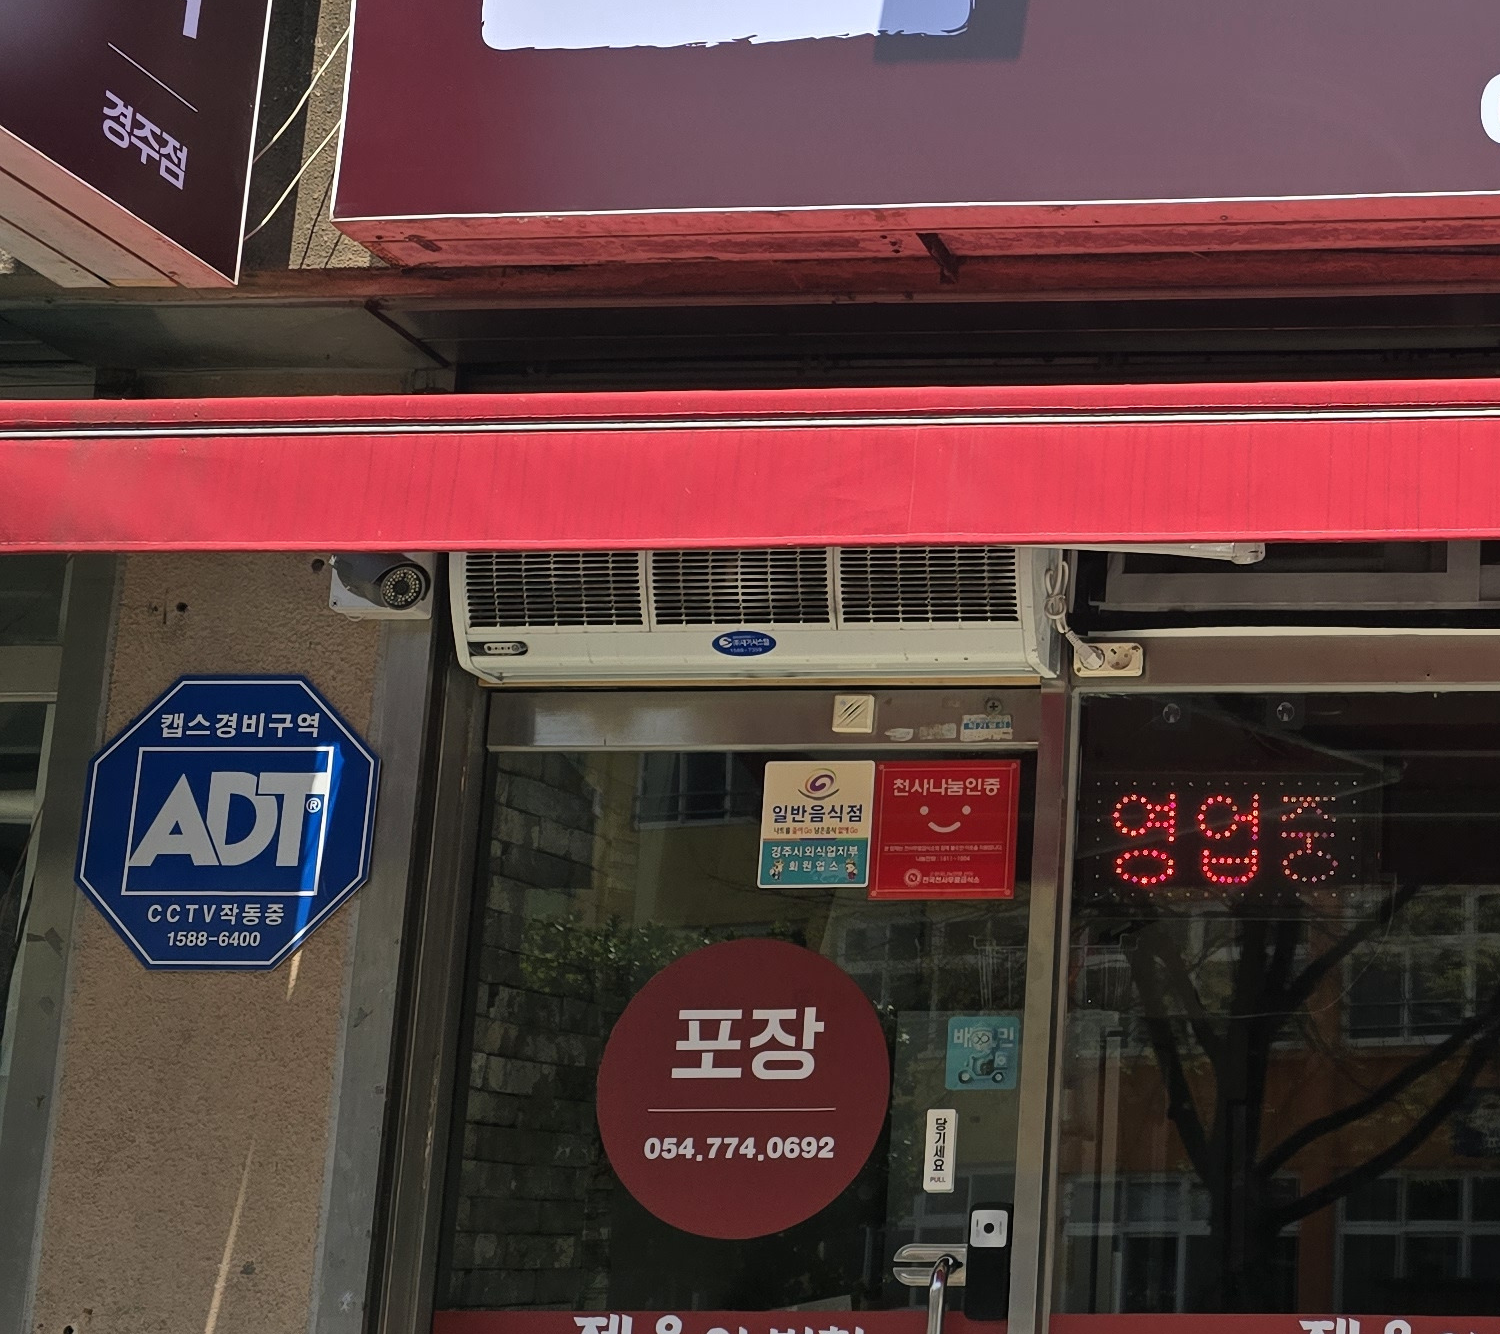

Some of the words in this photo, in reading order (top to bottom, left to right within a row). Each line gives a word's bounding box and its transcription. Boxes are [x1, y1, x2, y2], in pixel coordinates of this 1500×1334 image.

[102, 89, 188, 190] 경주점
[160, 713, 321, 738] 캡스경비구역
[893, 777, 1001, 797] 천사나눔인증
[128, 772, 331, 867] ADT
[772, 803, 864, 823] 일반음식점
[1112, 792, 1339, 885] 영업중
[771, 845, 859, 858] 경주시외식업지부
[147, 903, 285, 926] CCTV작동중
[167, 931, 261, 947] 1588-6400
[671, 1006, 825, 1081] 포장
[643, 1136, 835, 1162] 054.774.0692
[932, 1117, 948, 1172] 당기세요
